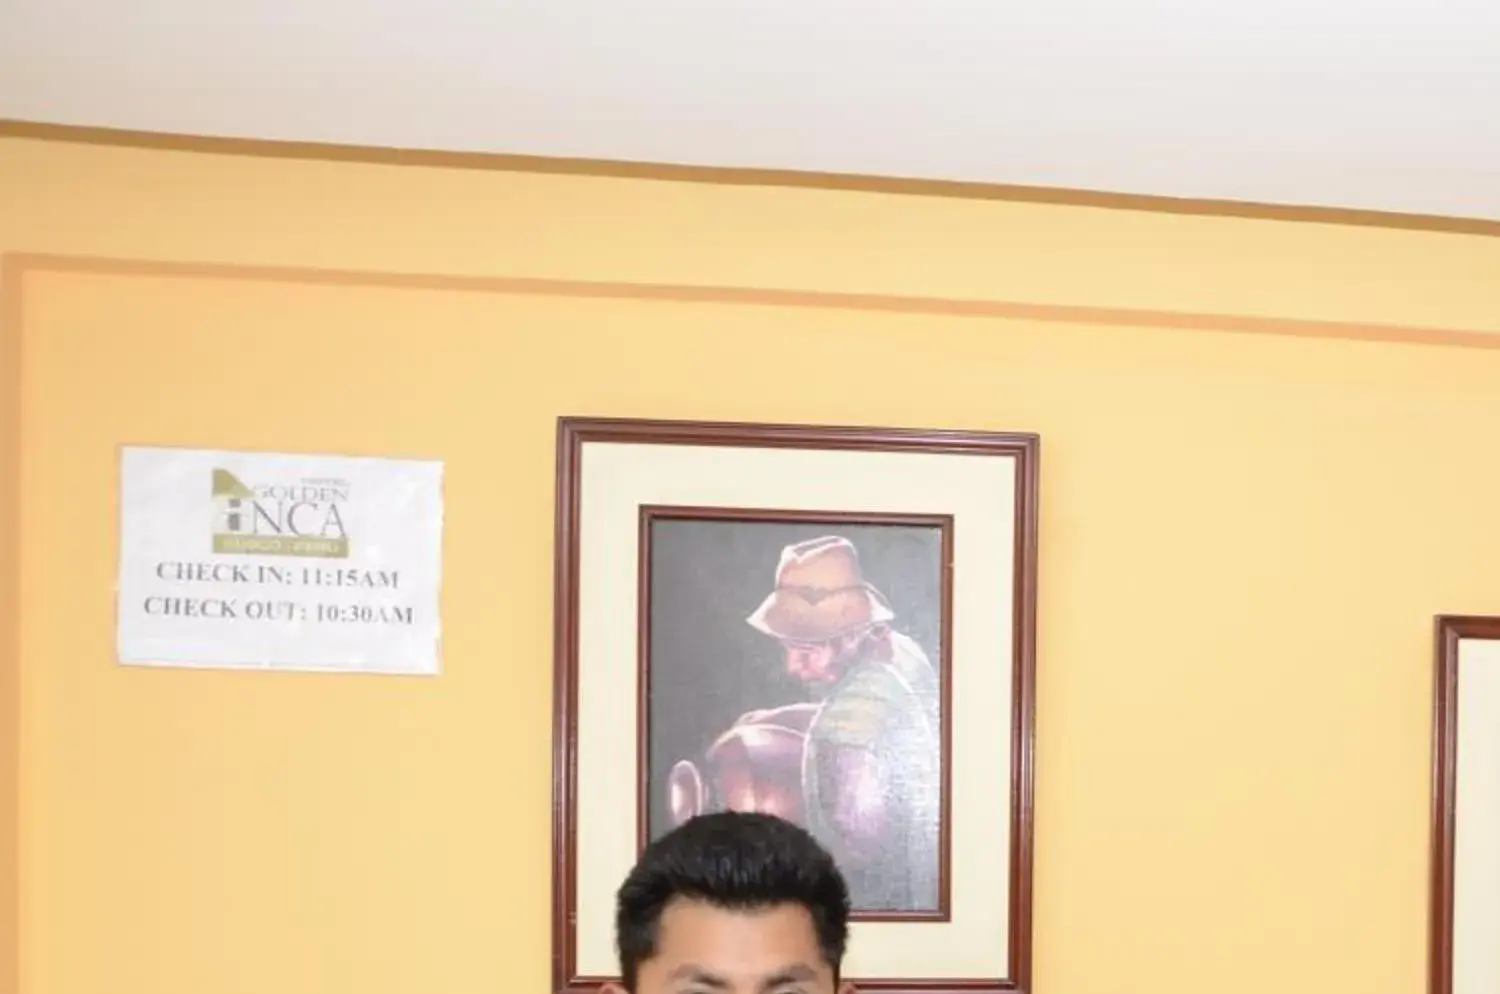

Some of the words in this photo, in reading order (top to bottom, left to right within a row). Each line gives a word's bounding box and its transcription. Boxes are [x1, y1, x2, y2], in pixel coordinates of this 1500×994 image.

[252, 483, 348, 502] GOLDEN
[156, 560, 249, 583] CHECK
[257, 564, 292, 585] IN:
[302, 567, 399, 589] 11:15AM
[143, 596, 237, 618] CHECK
[316, 603, 414, 624] 10:30AM
